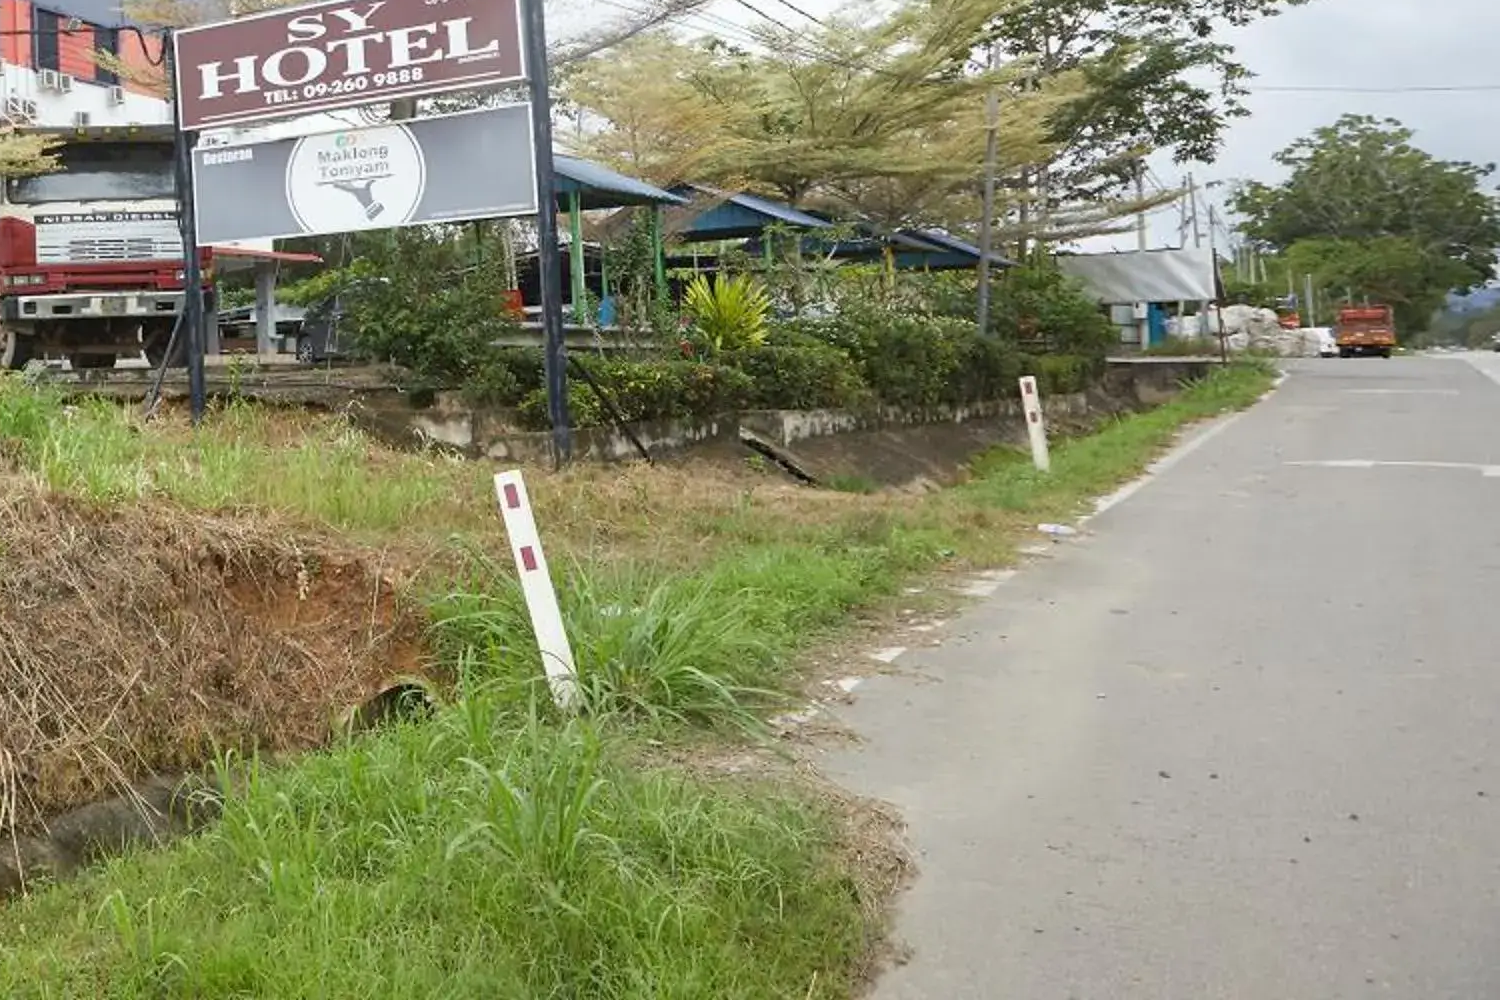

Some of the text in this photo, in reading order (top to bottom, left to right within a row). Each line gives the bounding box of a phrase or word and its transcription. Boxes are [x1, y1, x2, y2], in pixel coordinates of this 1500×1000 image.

[286, 1, 386, 43] SY
[196, 16, 499, 101] HOTEL
[263, 66, 424, 105] TEL: 09-260 9888
[317, 145, 389, 164] Maklong
[43, 211, 176, 224] NISSAN DIESEL
